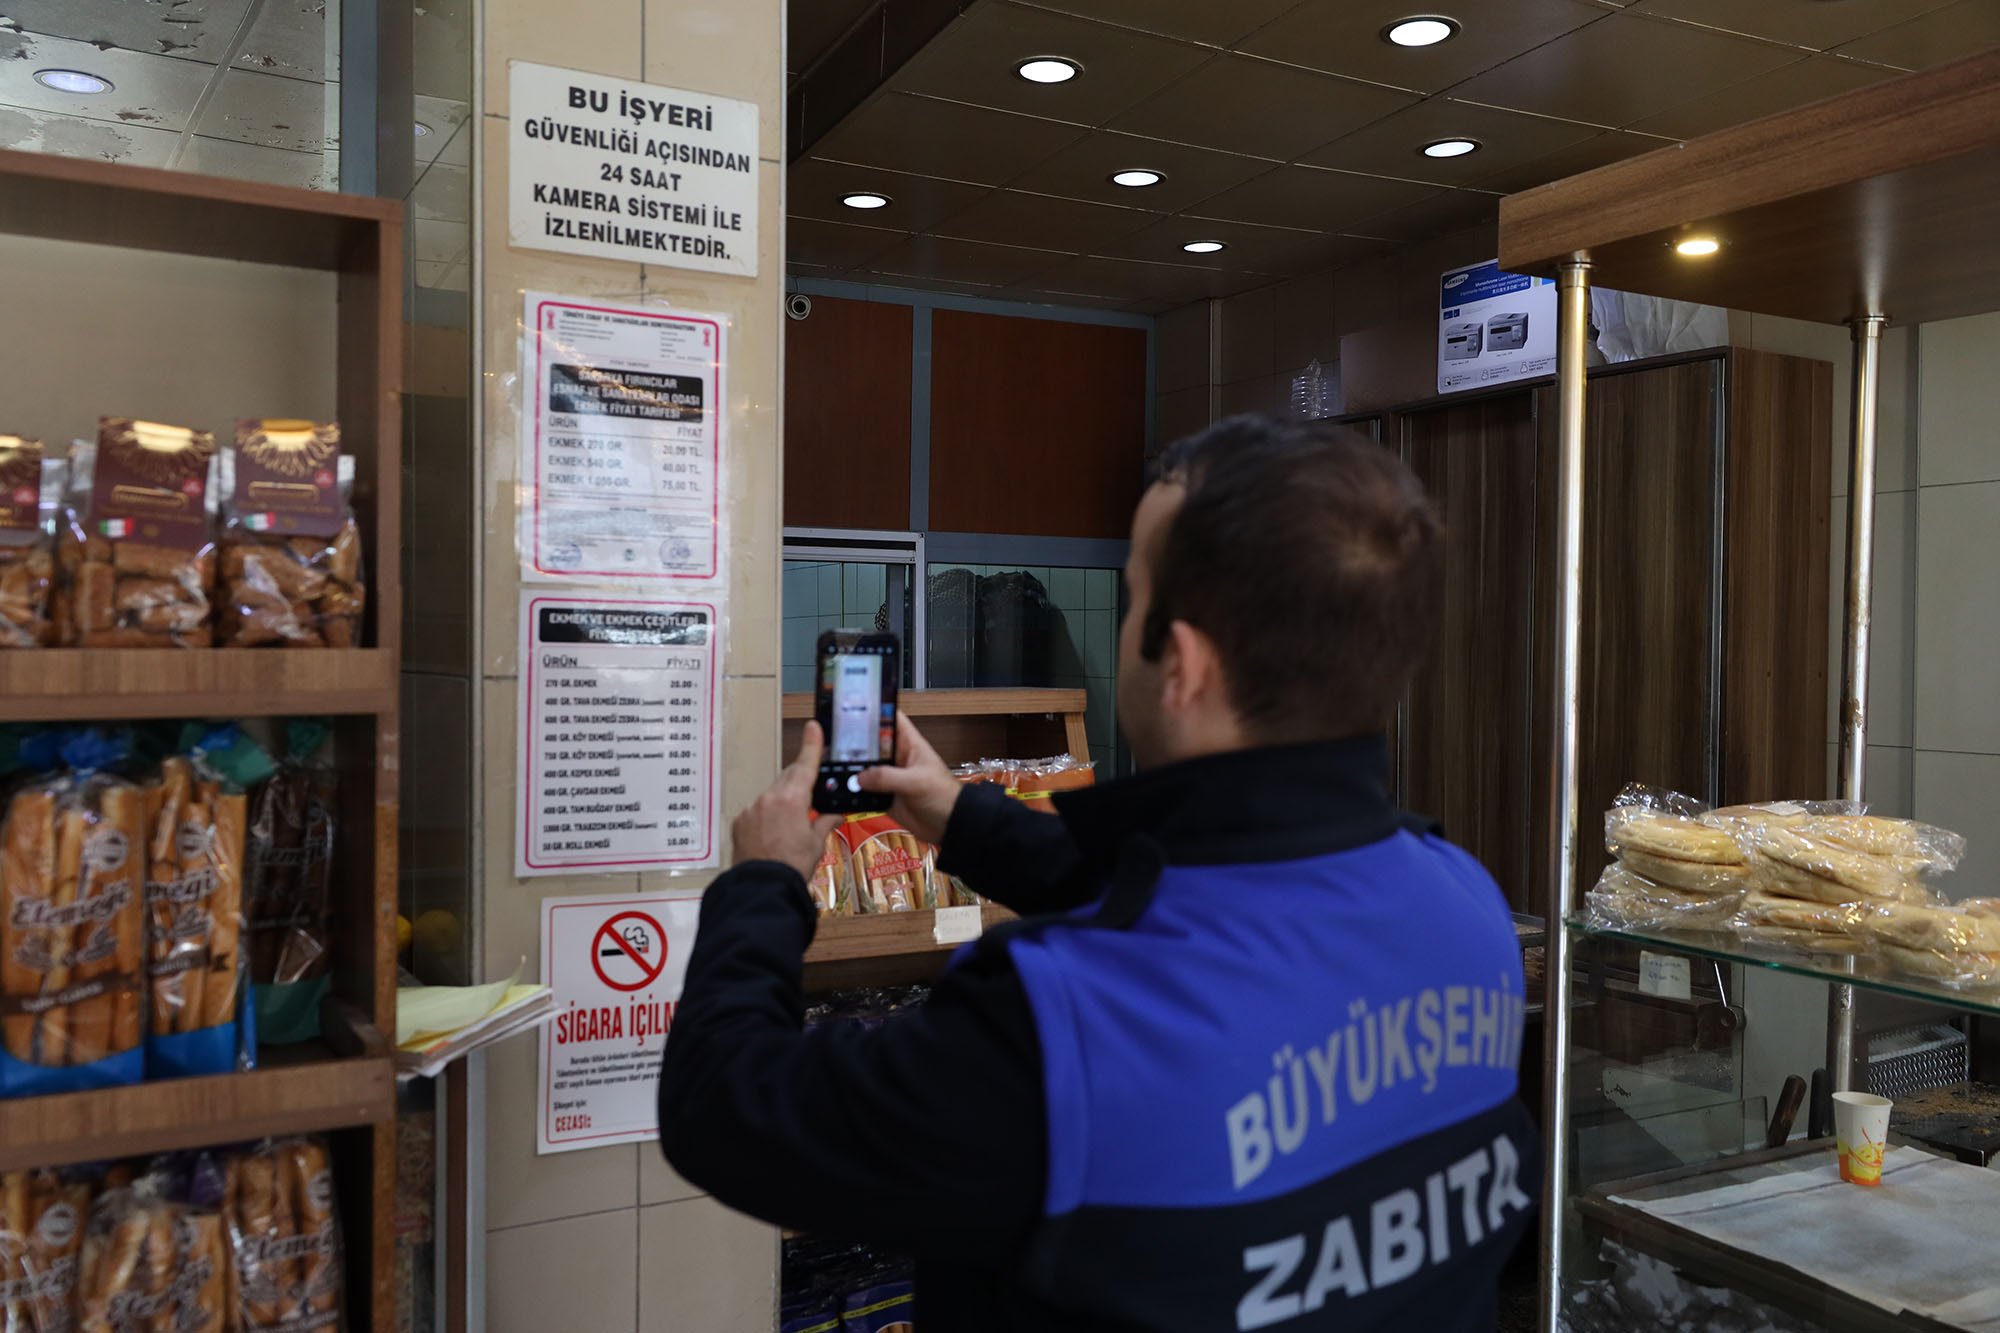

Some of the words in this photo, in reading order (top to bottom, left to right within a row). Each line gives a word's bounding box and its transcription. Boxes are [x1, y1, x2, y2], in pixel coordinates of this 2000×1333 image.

[568, 86, 609, 113] BU
[620, 90, 713, 131] İŞYERİ
[524, 116, 638, 155] GÜVENLİĞİ
[645, 139, 750, 173] AÇISINDAN
[600, 163, 623, 181] 24
[630, 167, 682, 191] SAAT
[533, 183, 620, 214] KAMERA
[627, 195, 706, 226] SİSTEMİ
[713, 205, 742, 231] İLE
[545, 212, 731, 260] İZLENİLMEKTEDİR.
[610, 402, 637, 414] FİYAT
[548, 437, 583, 449] EKMEK
[548, 455, 583, 467] EKMEK
[548, 473, 584, 485] EKMEK
[549, 612, 587, 624] EKMEK
[590, 614, 604, 625] VE
[606, 614, 643, 626] EKMEK
[644, 614, 699, 629] ÇEŞİTLERİ
[542, 654, 578, 668] ÜRÜN
[666, 656, 701, 670] FİYATI
[557, 1001, 623, 1045] SİGARA
[1235, 1133, 1531, 1333] ZABITA
